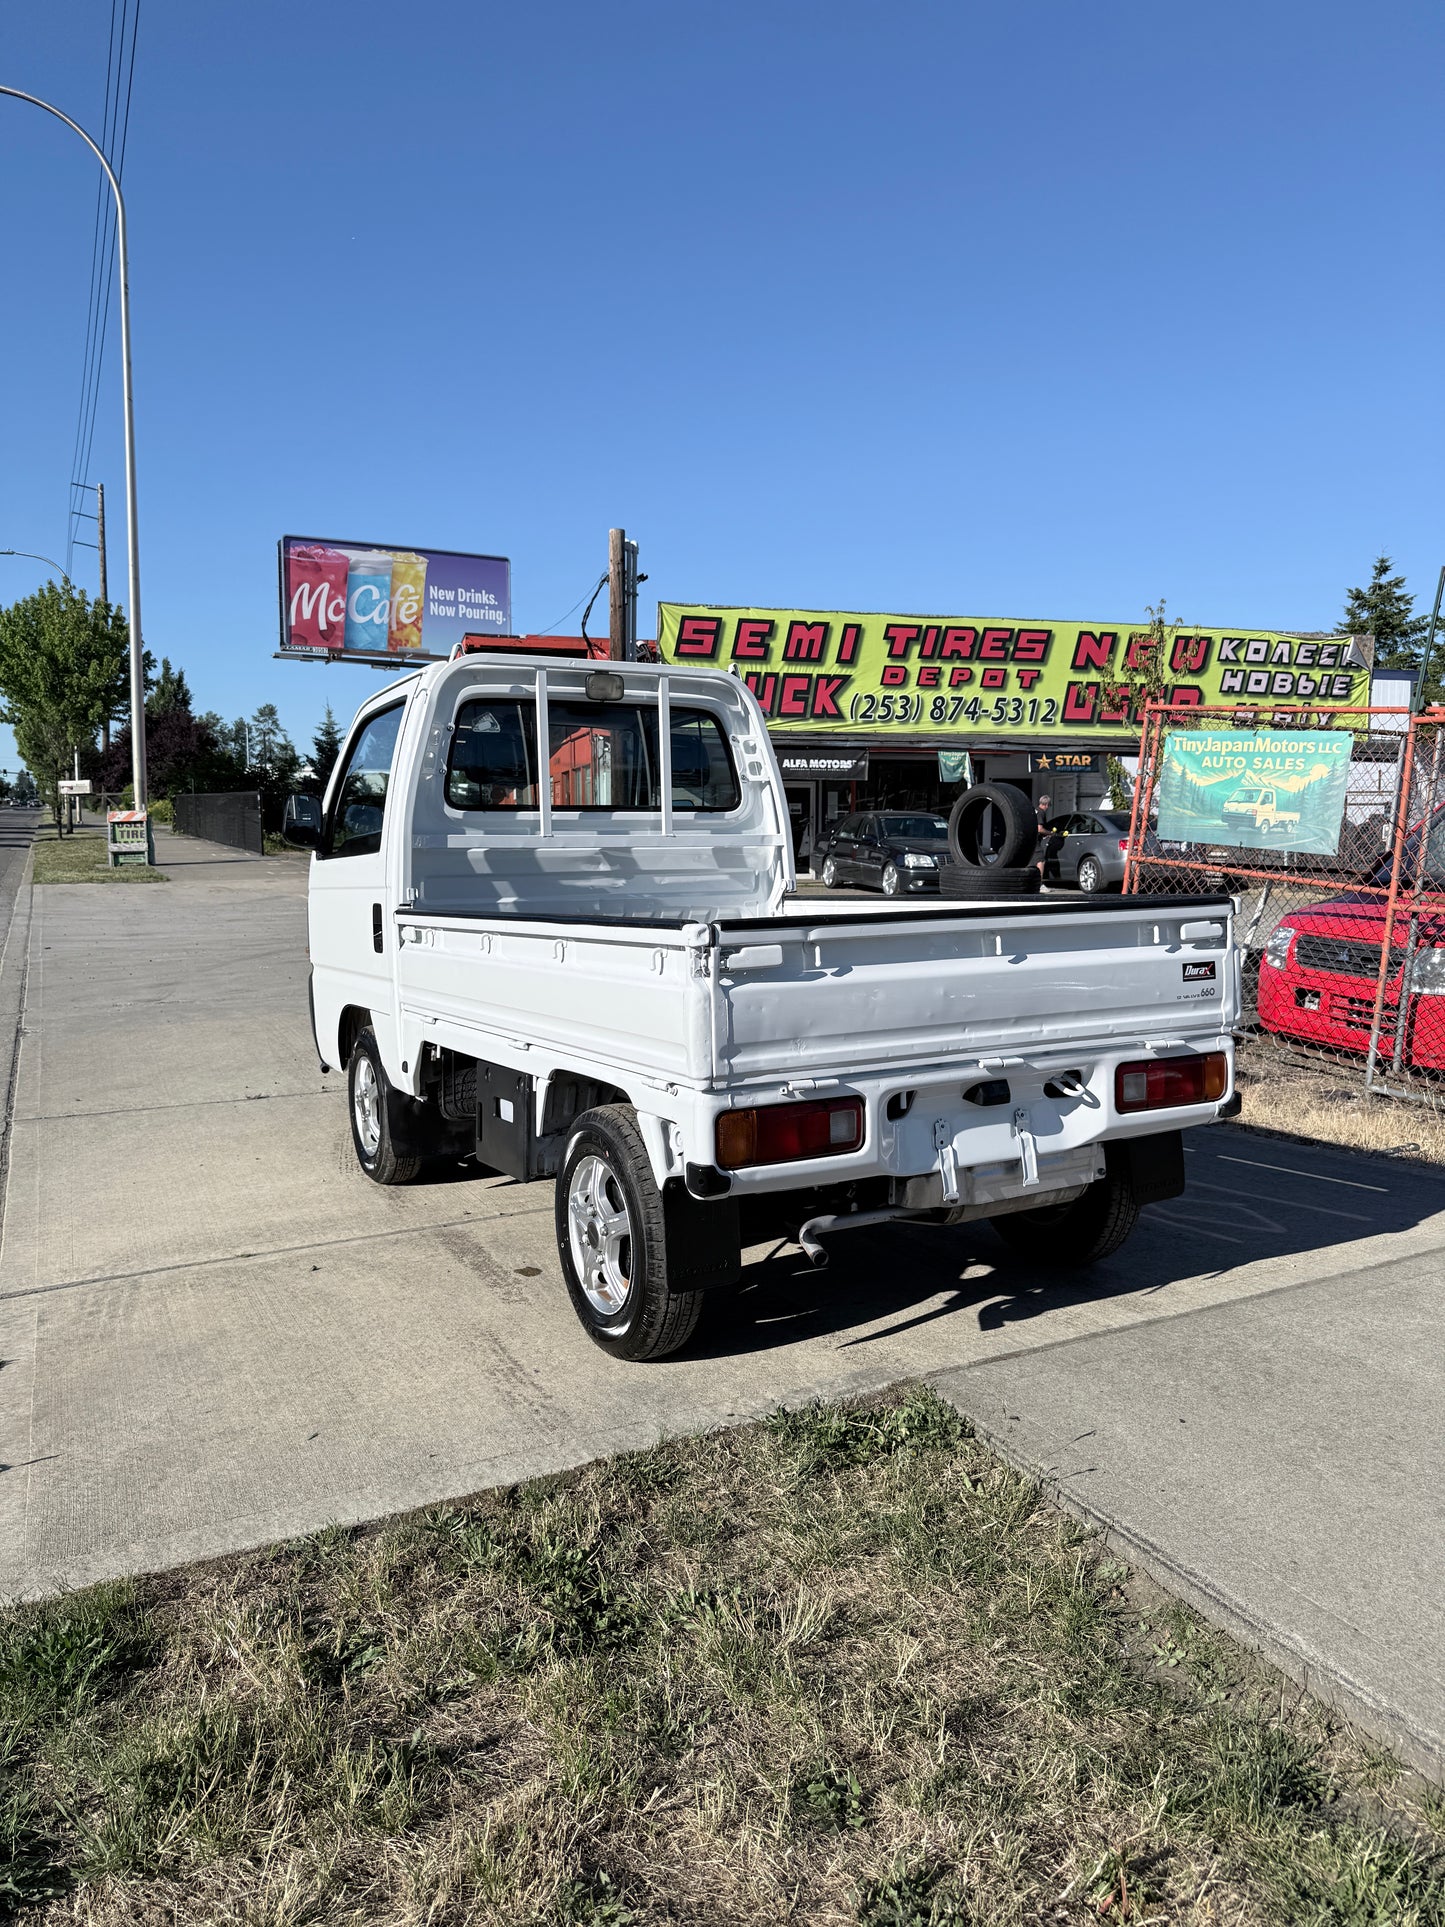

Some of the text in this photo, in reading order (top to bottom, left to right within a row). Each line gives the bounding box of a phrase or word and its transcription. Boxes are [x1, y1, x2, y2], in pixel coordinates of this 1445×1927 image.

[429, 586, 498, 605] New Drinks.
[430, 602, 506, 625] Now Pouring.
[673, 615, 862, 664] SEMI
[883, 623, 1052, 664] TIRES
[1070, 631, 1213, 674] NEW
[880, 665, 1041, 690] DEPOT
[1219, 668, 1354, 698] НОВЫЕ
[743, 671, 853, 719] UCK
[850, 692, 1057, 723] (253) 874-5312
[1173, 736, 1343, 755] TinyJapanMotors LLC
[782, 759, 808, 768] ALFA
[1055, 755, 1092, 766] STAR
[1201, 756, 1306, 770] AUTO SALES
[1200, 987, 1215, 997] 660
